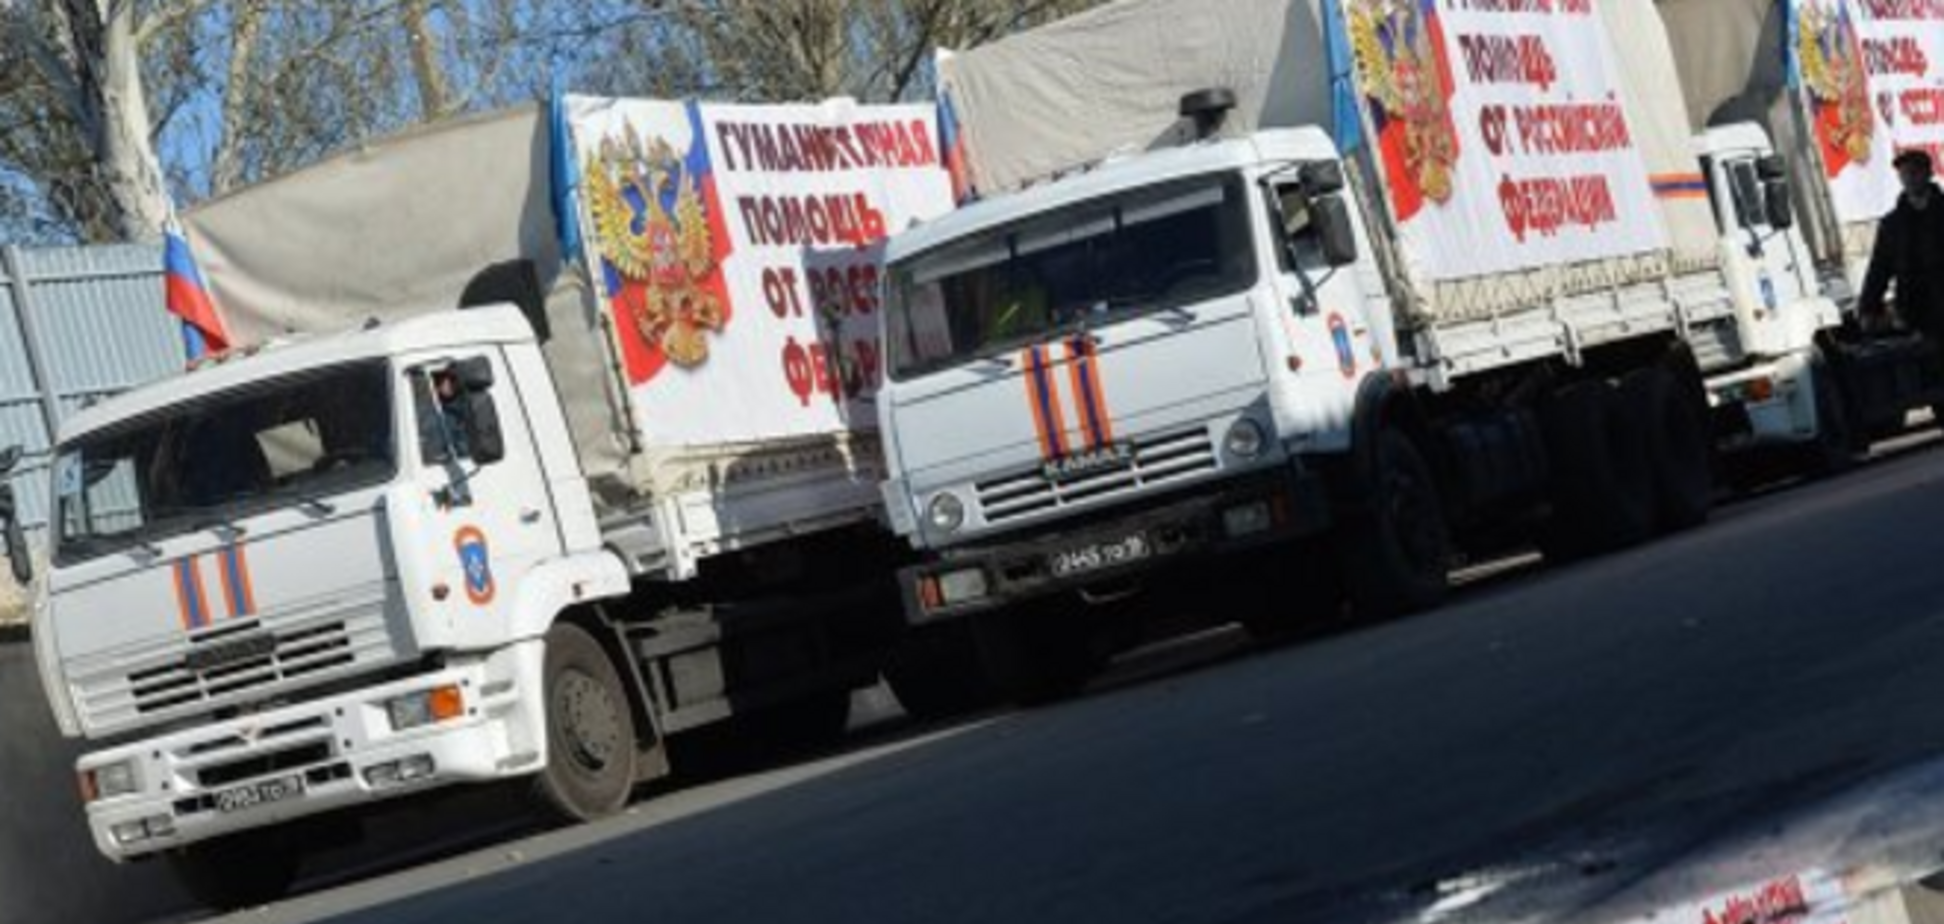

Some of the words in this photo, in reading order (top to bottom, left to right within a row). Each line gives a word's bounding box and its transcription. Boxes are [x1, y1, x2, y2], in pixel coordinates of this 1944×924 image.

[1480, 104, 1513, 156] ОТ
[738, 192, 887, 250] ПОМОЩЬ
[762, 267, 803, 319] ОТ
